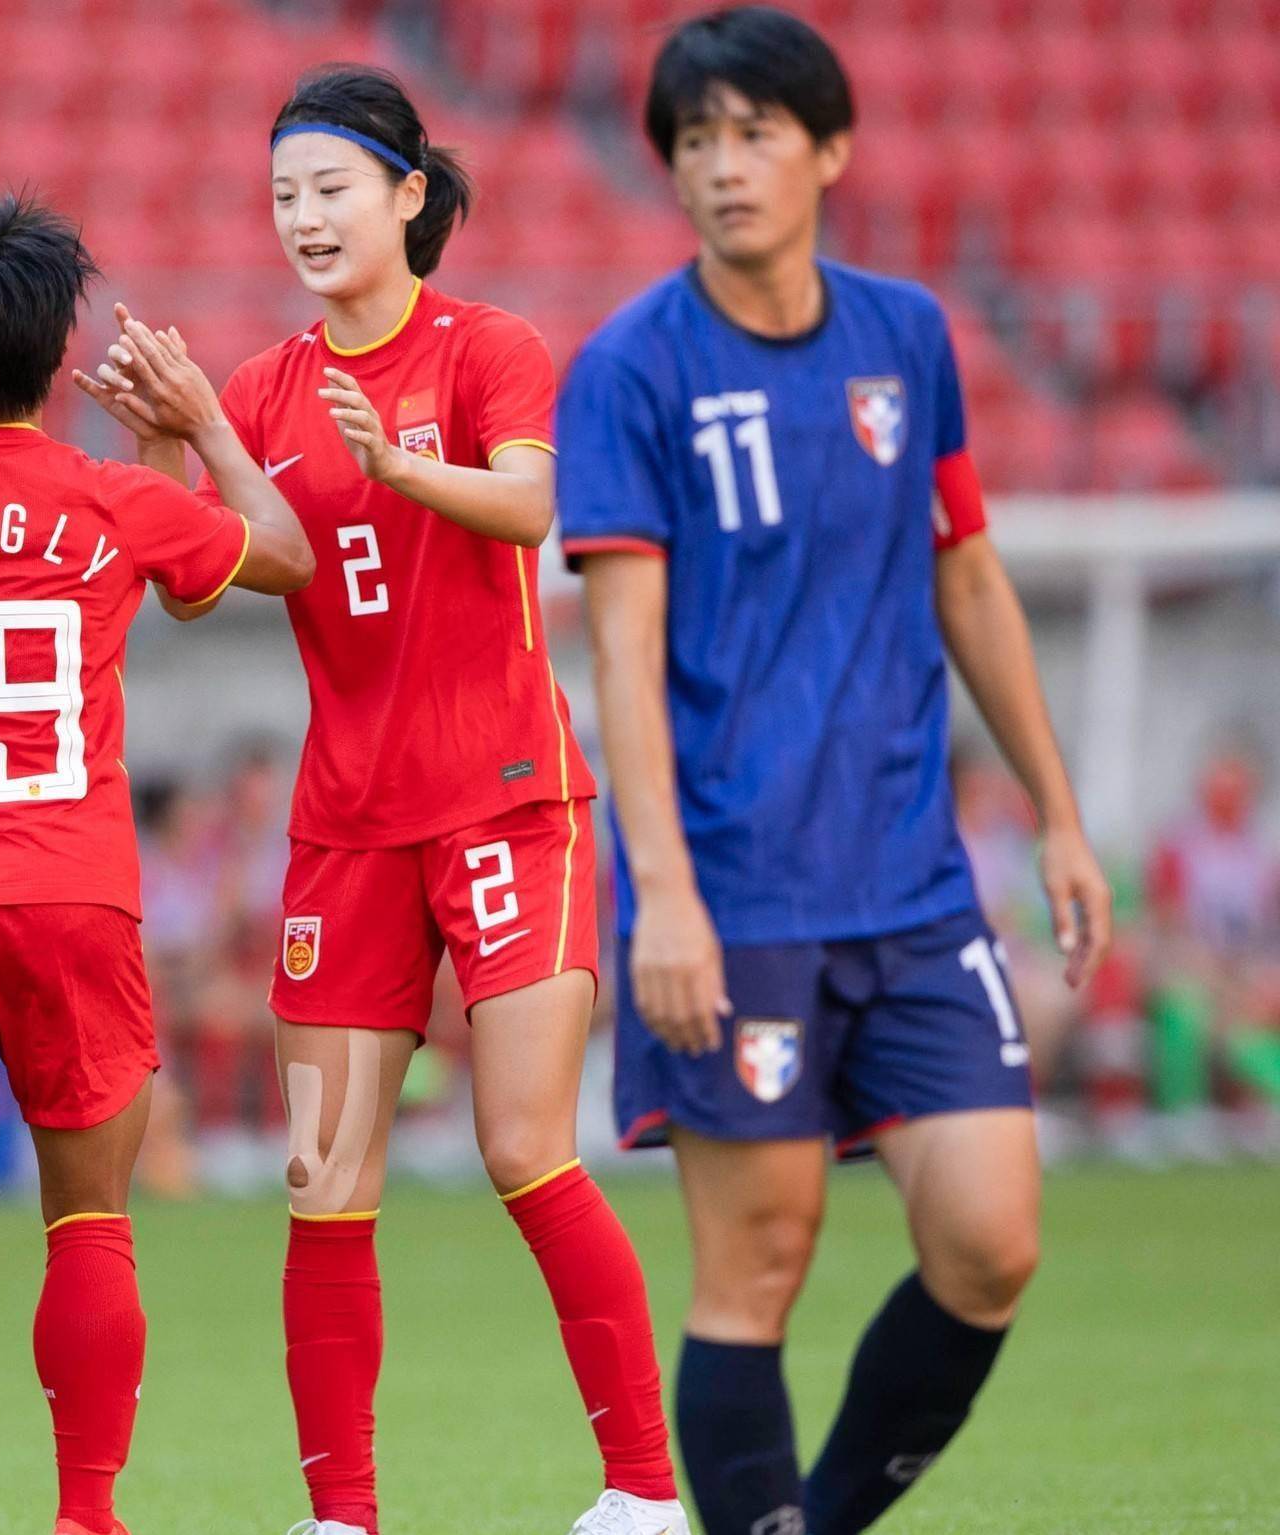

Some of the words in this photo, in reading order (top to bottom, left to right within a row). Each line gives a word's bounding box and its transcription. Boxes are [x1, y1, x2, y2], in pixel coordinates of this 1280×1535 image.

[404, 431, 434, 447] CFA
[692, 416, 783, 533] 11
[43, 513, 68, 565] L
[81, 534, 119, 582] Y
[337, 523, 390, 616] 2
[289, 924, 316, 936] CFA
[465, 840, 520, 932] 2
[960, 938, 1018, 1042] 1
